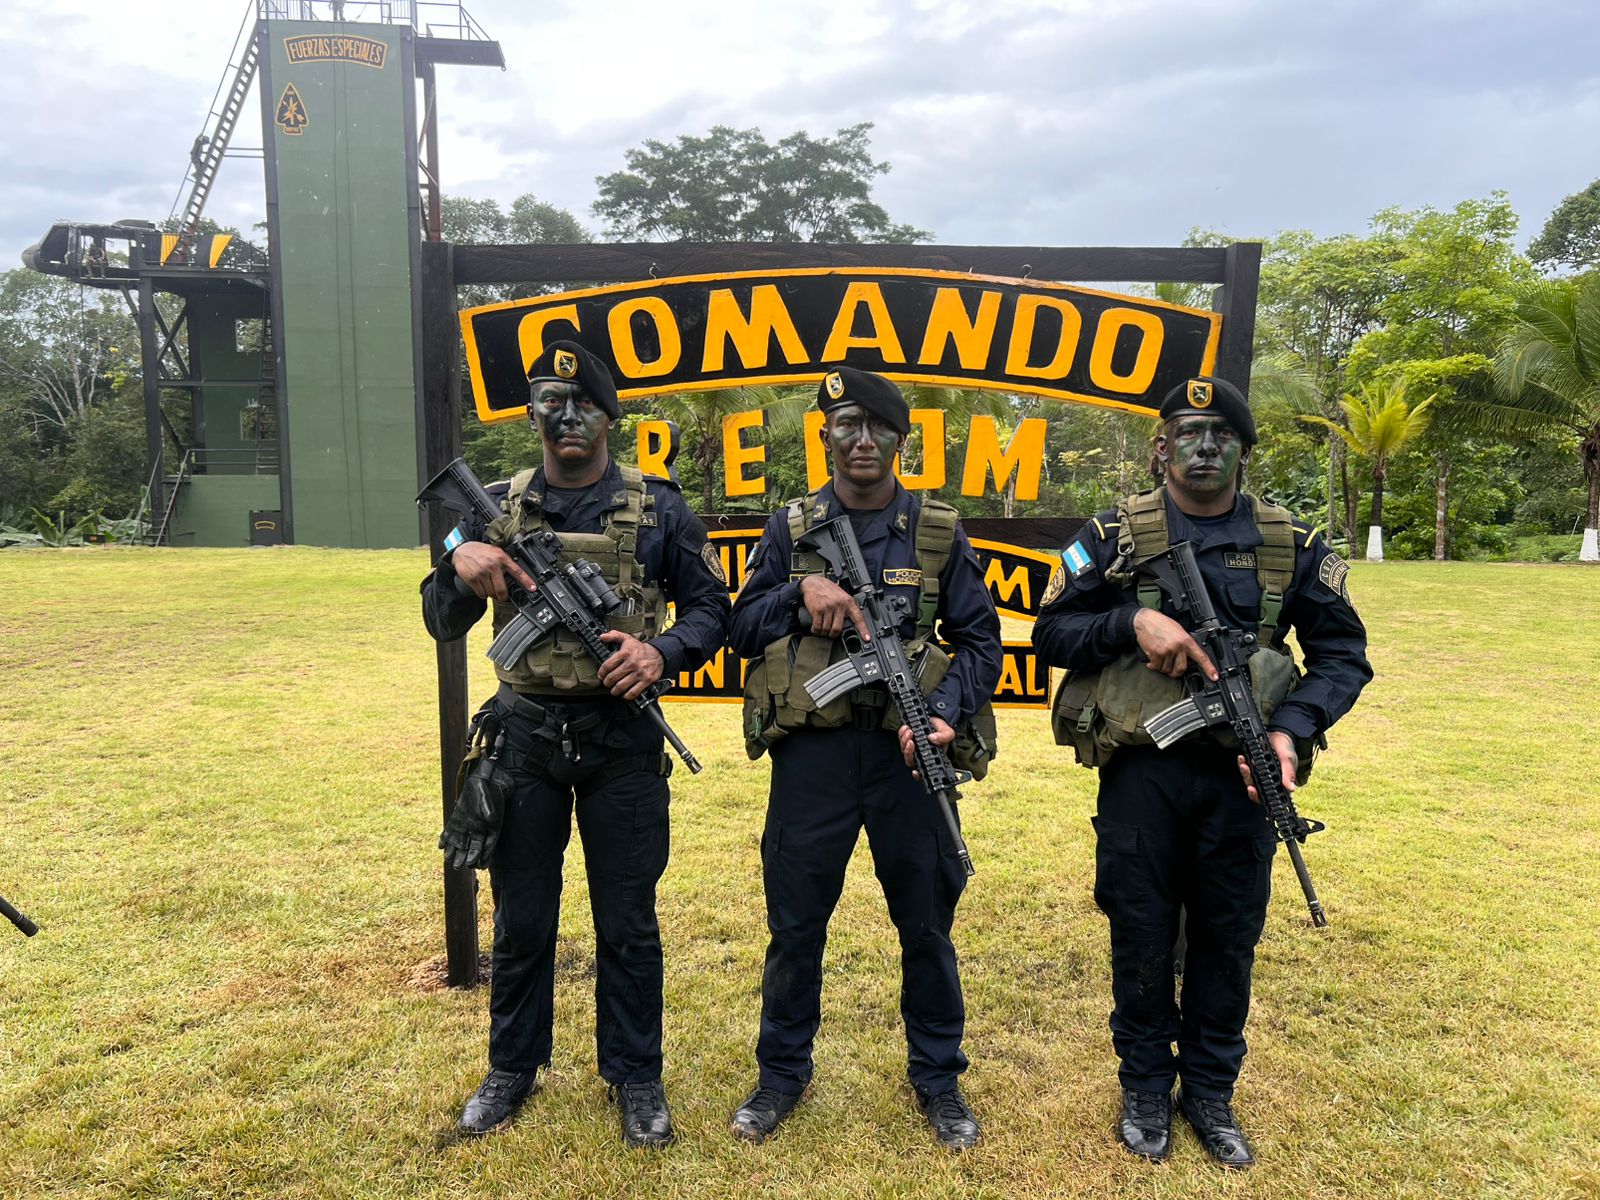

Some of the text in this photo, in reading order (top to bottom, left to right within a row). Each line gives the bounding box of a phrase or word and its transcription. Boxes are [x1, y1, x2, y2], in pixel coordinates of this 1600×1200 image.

[289, 38, 382, 63] FUERZAS ESPECIALES
[517, 281, 1165, 395] COMANDO
